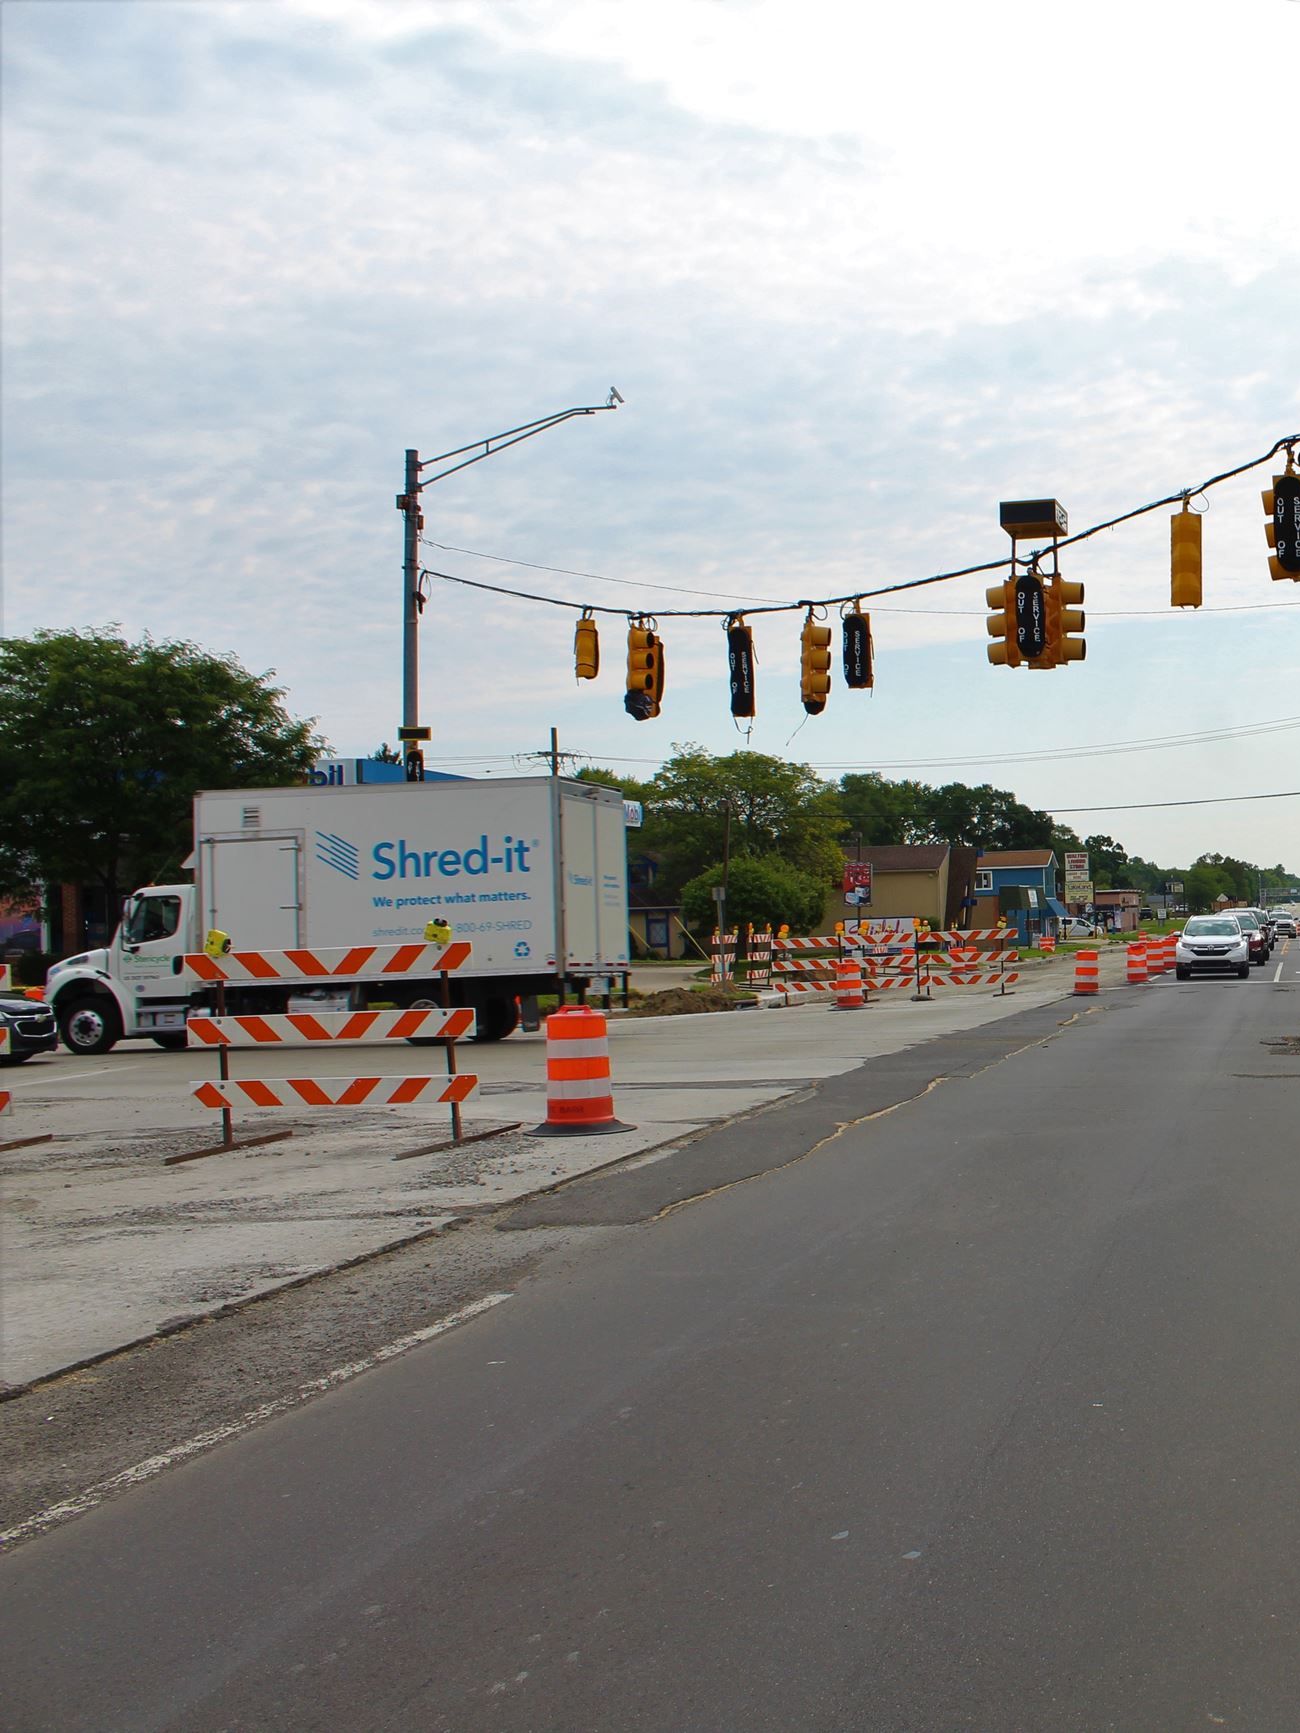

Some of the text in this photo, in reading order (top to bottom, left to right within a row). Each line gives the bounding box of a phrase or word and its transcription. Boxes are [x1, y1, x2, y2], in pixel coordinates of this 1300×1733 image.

[1277, 541, 1285, 558] OF
[1033, 592, 1041, 642] SERVICE
[1018, 628, 1025, 643] OF
[741, 651, 750, 694] SERVICE
[309, 765, 343, 786] bil
[371, 834, 531, 880] Shred-it
[372, 891, 532, 910] We protect what matters.
[371, 920, 533, 938] shredit.co -800-69-SHRED
